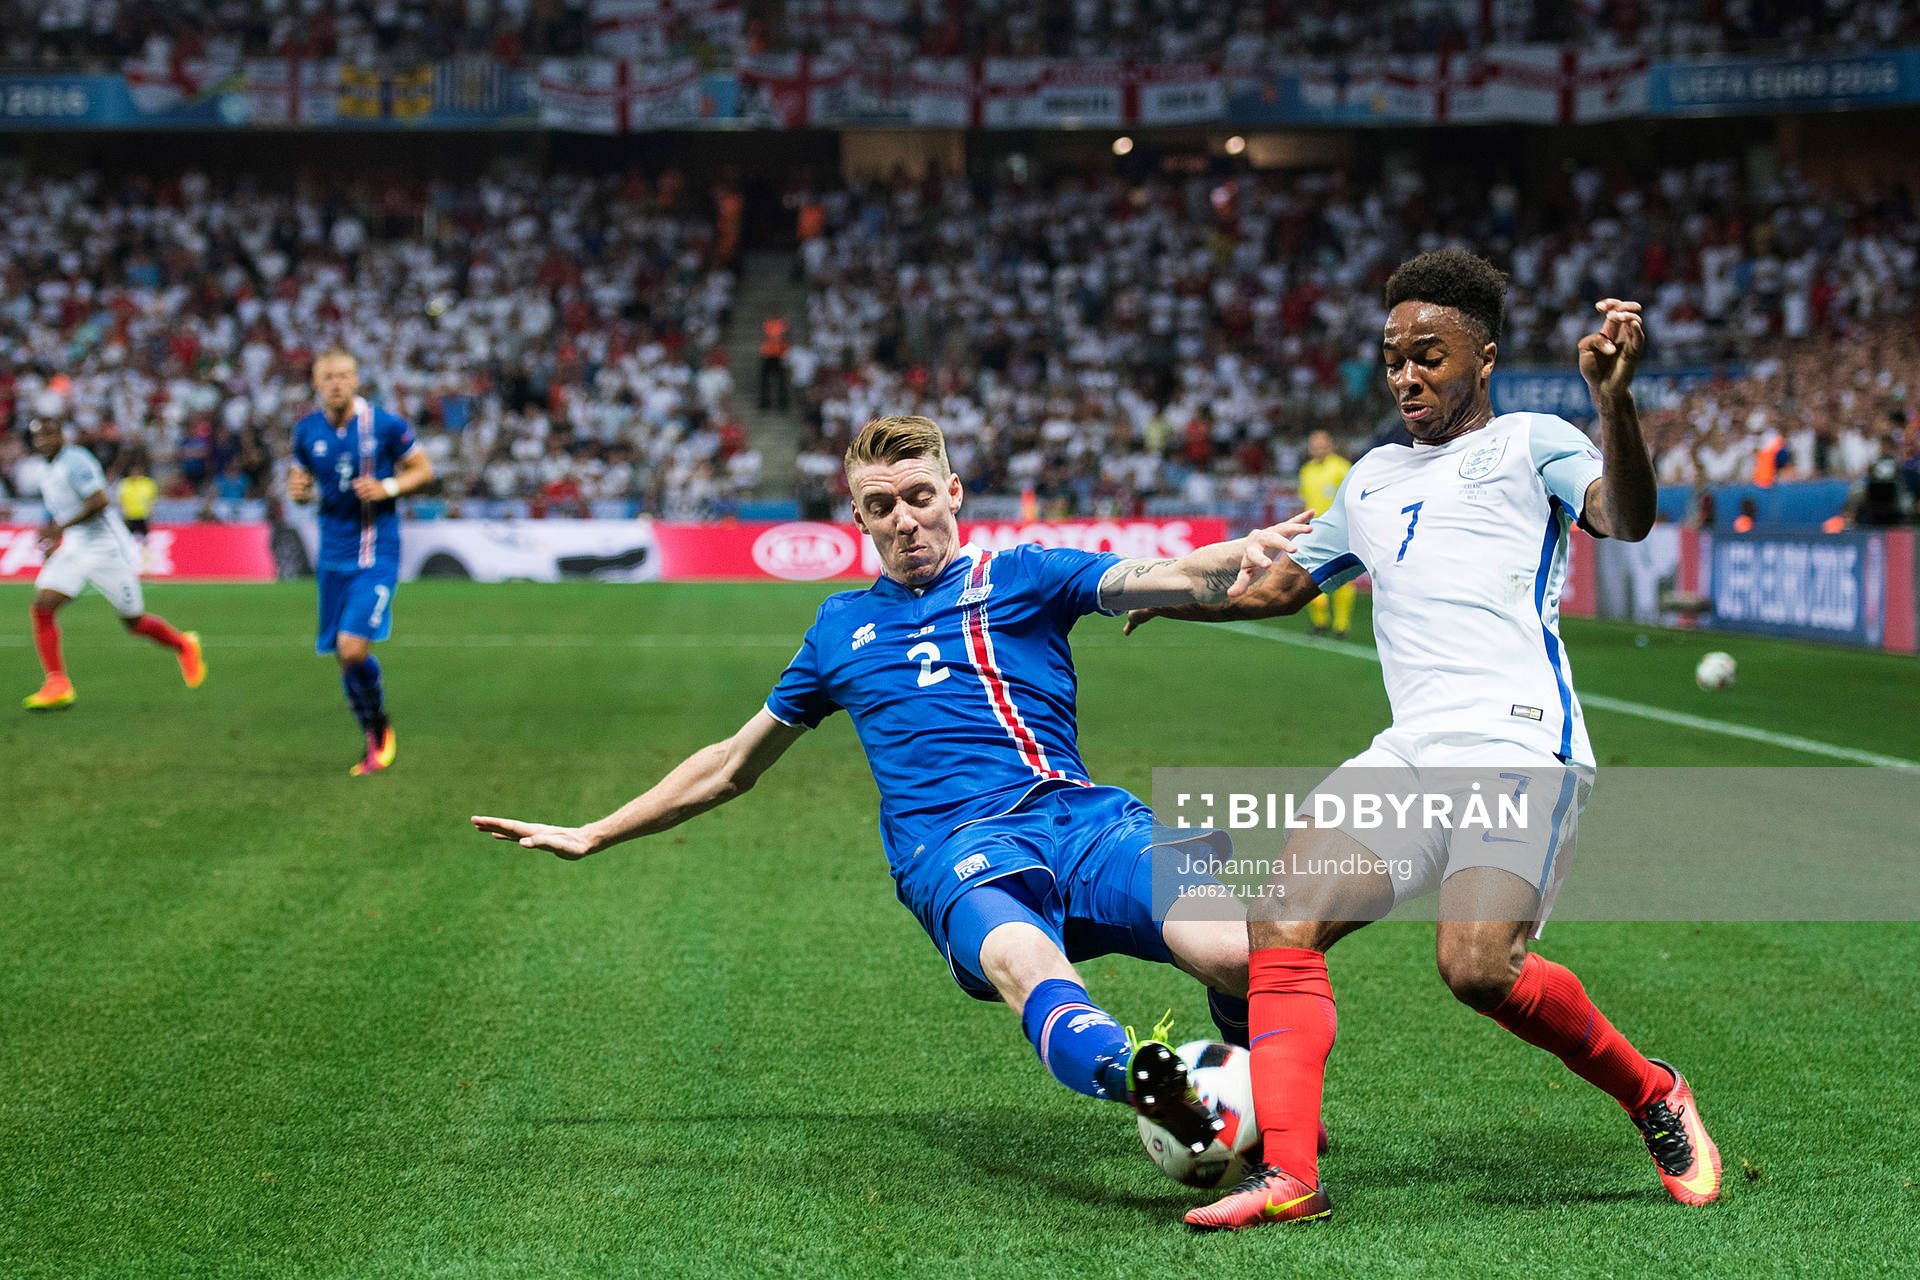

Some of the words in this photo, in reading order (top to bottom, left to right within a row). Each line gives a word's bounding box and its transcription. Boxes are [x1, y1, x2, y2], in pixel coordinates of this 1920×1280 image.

[1753, 66, 1826, 98] EURO
[1396, 500, 1424, 562] 7
[368, 584, 390, 628] 7
[906, 641, 951, 688] 2
